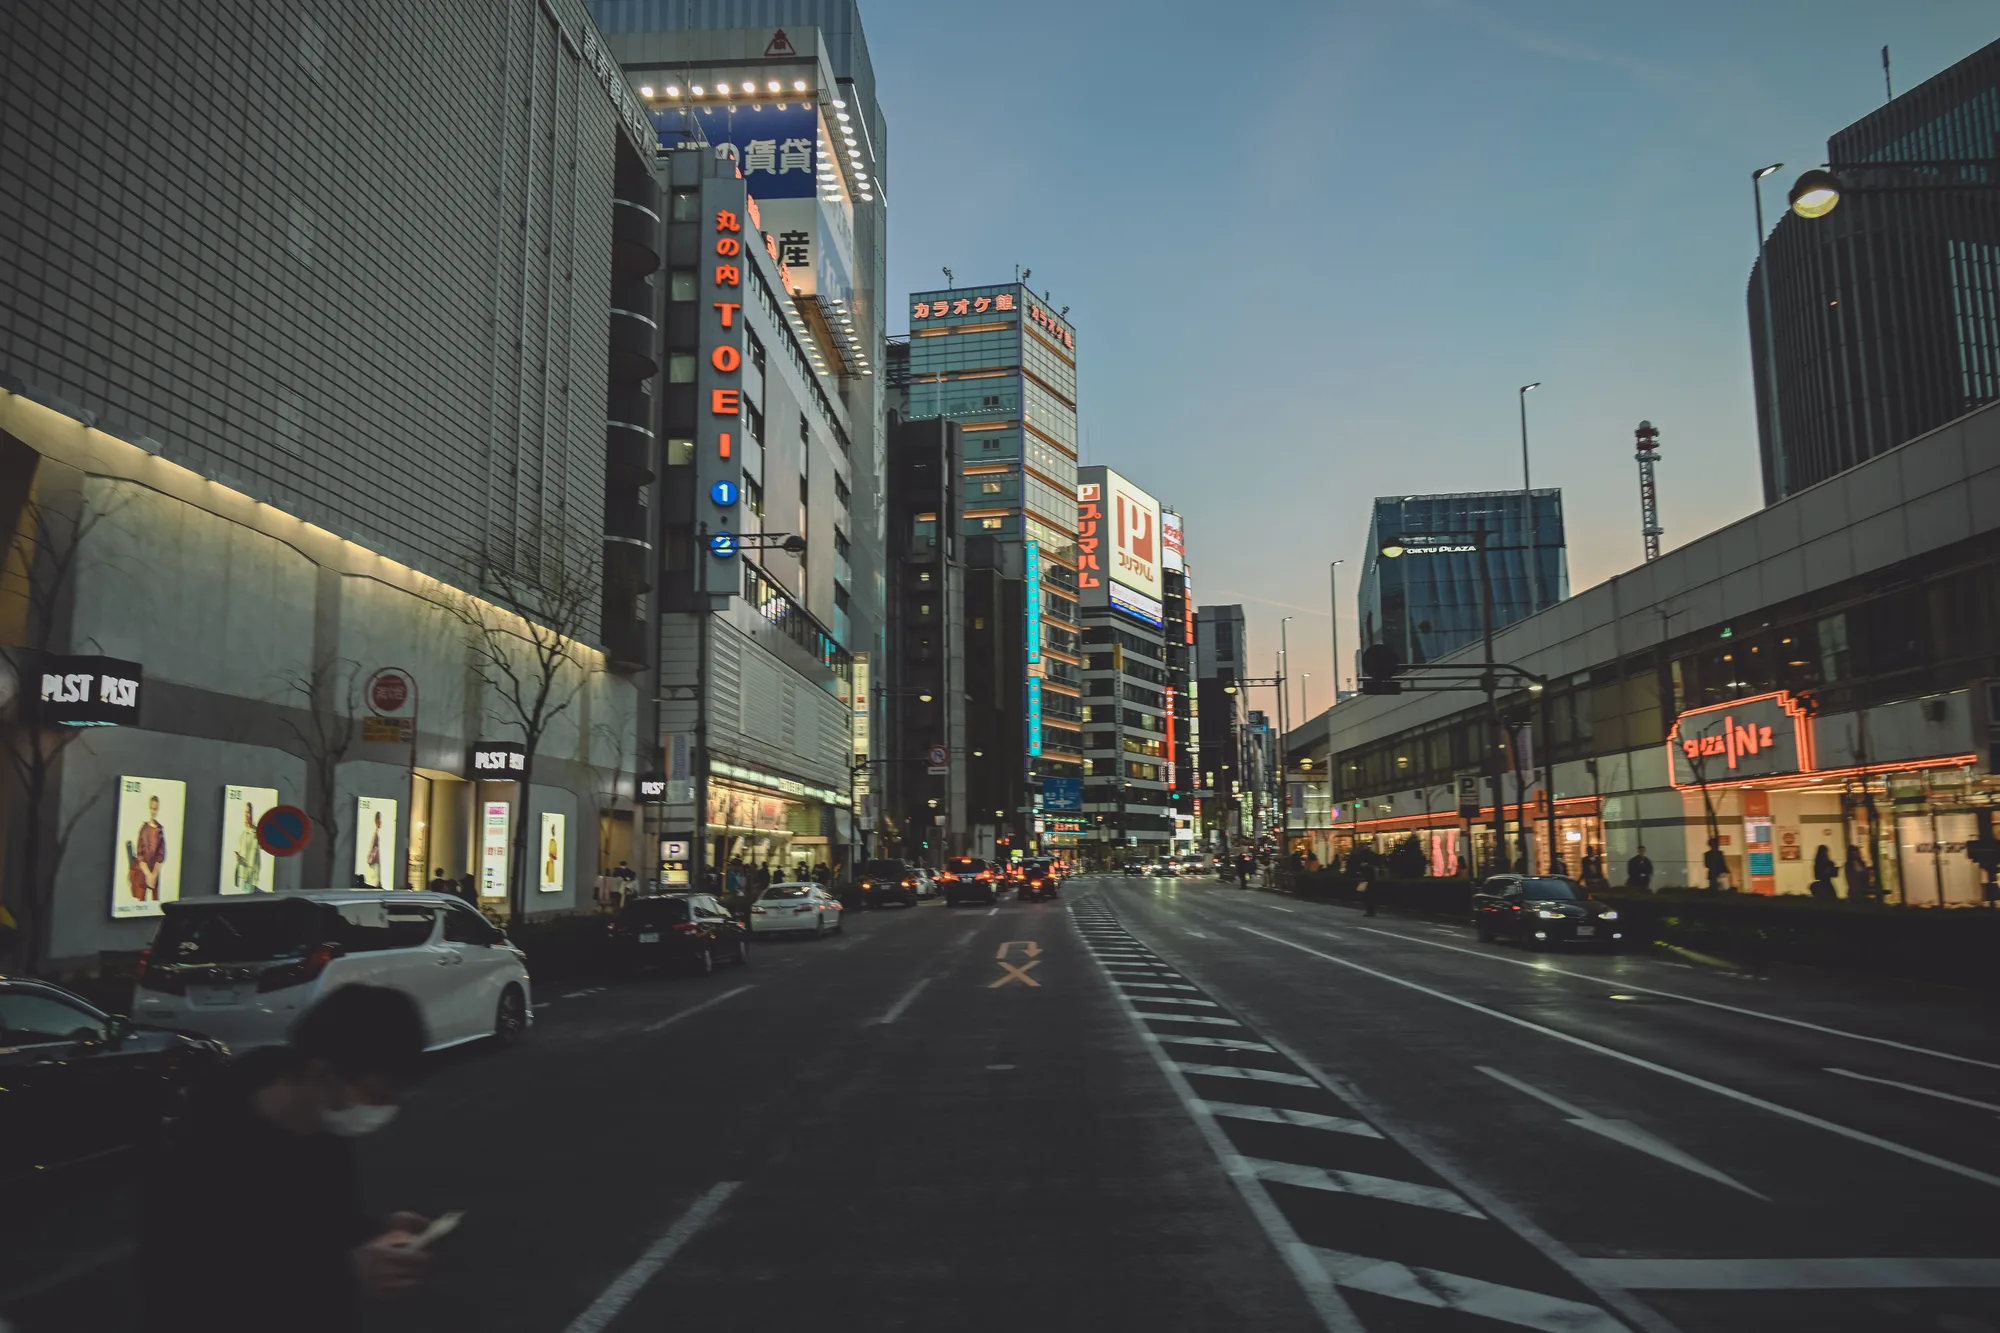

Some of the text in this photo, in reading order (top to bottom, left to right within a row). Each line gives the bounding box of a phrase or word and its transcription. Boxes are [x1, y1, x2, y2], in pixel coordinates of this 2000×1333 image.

[716, 209, 740, 286] 丸の内
[913, 293, 1014, 319] カラオケ館
[711, 302, 741, 459] TOEI
[1078, 503, 1102, 588] プリマハム
[1438, 545, 1477, 553] PLAZA
